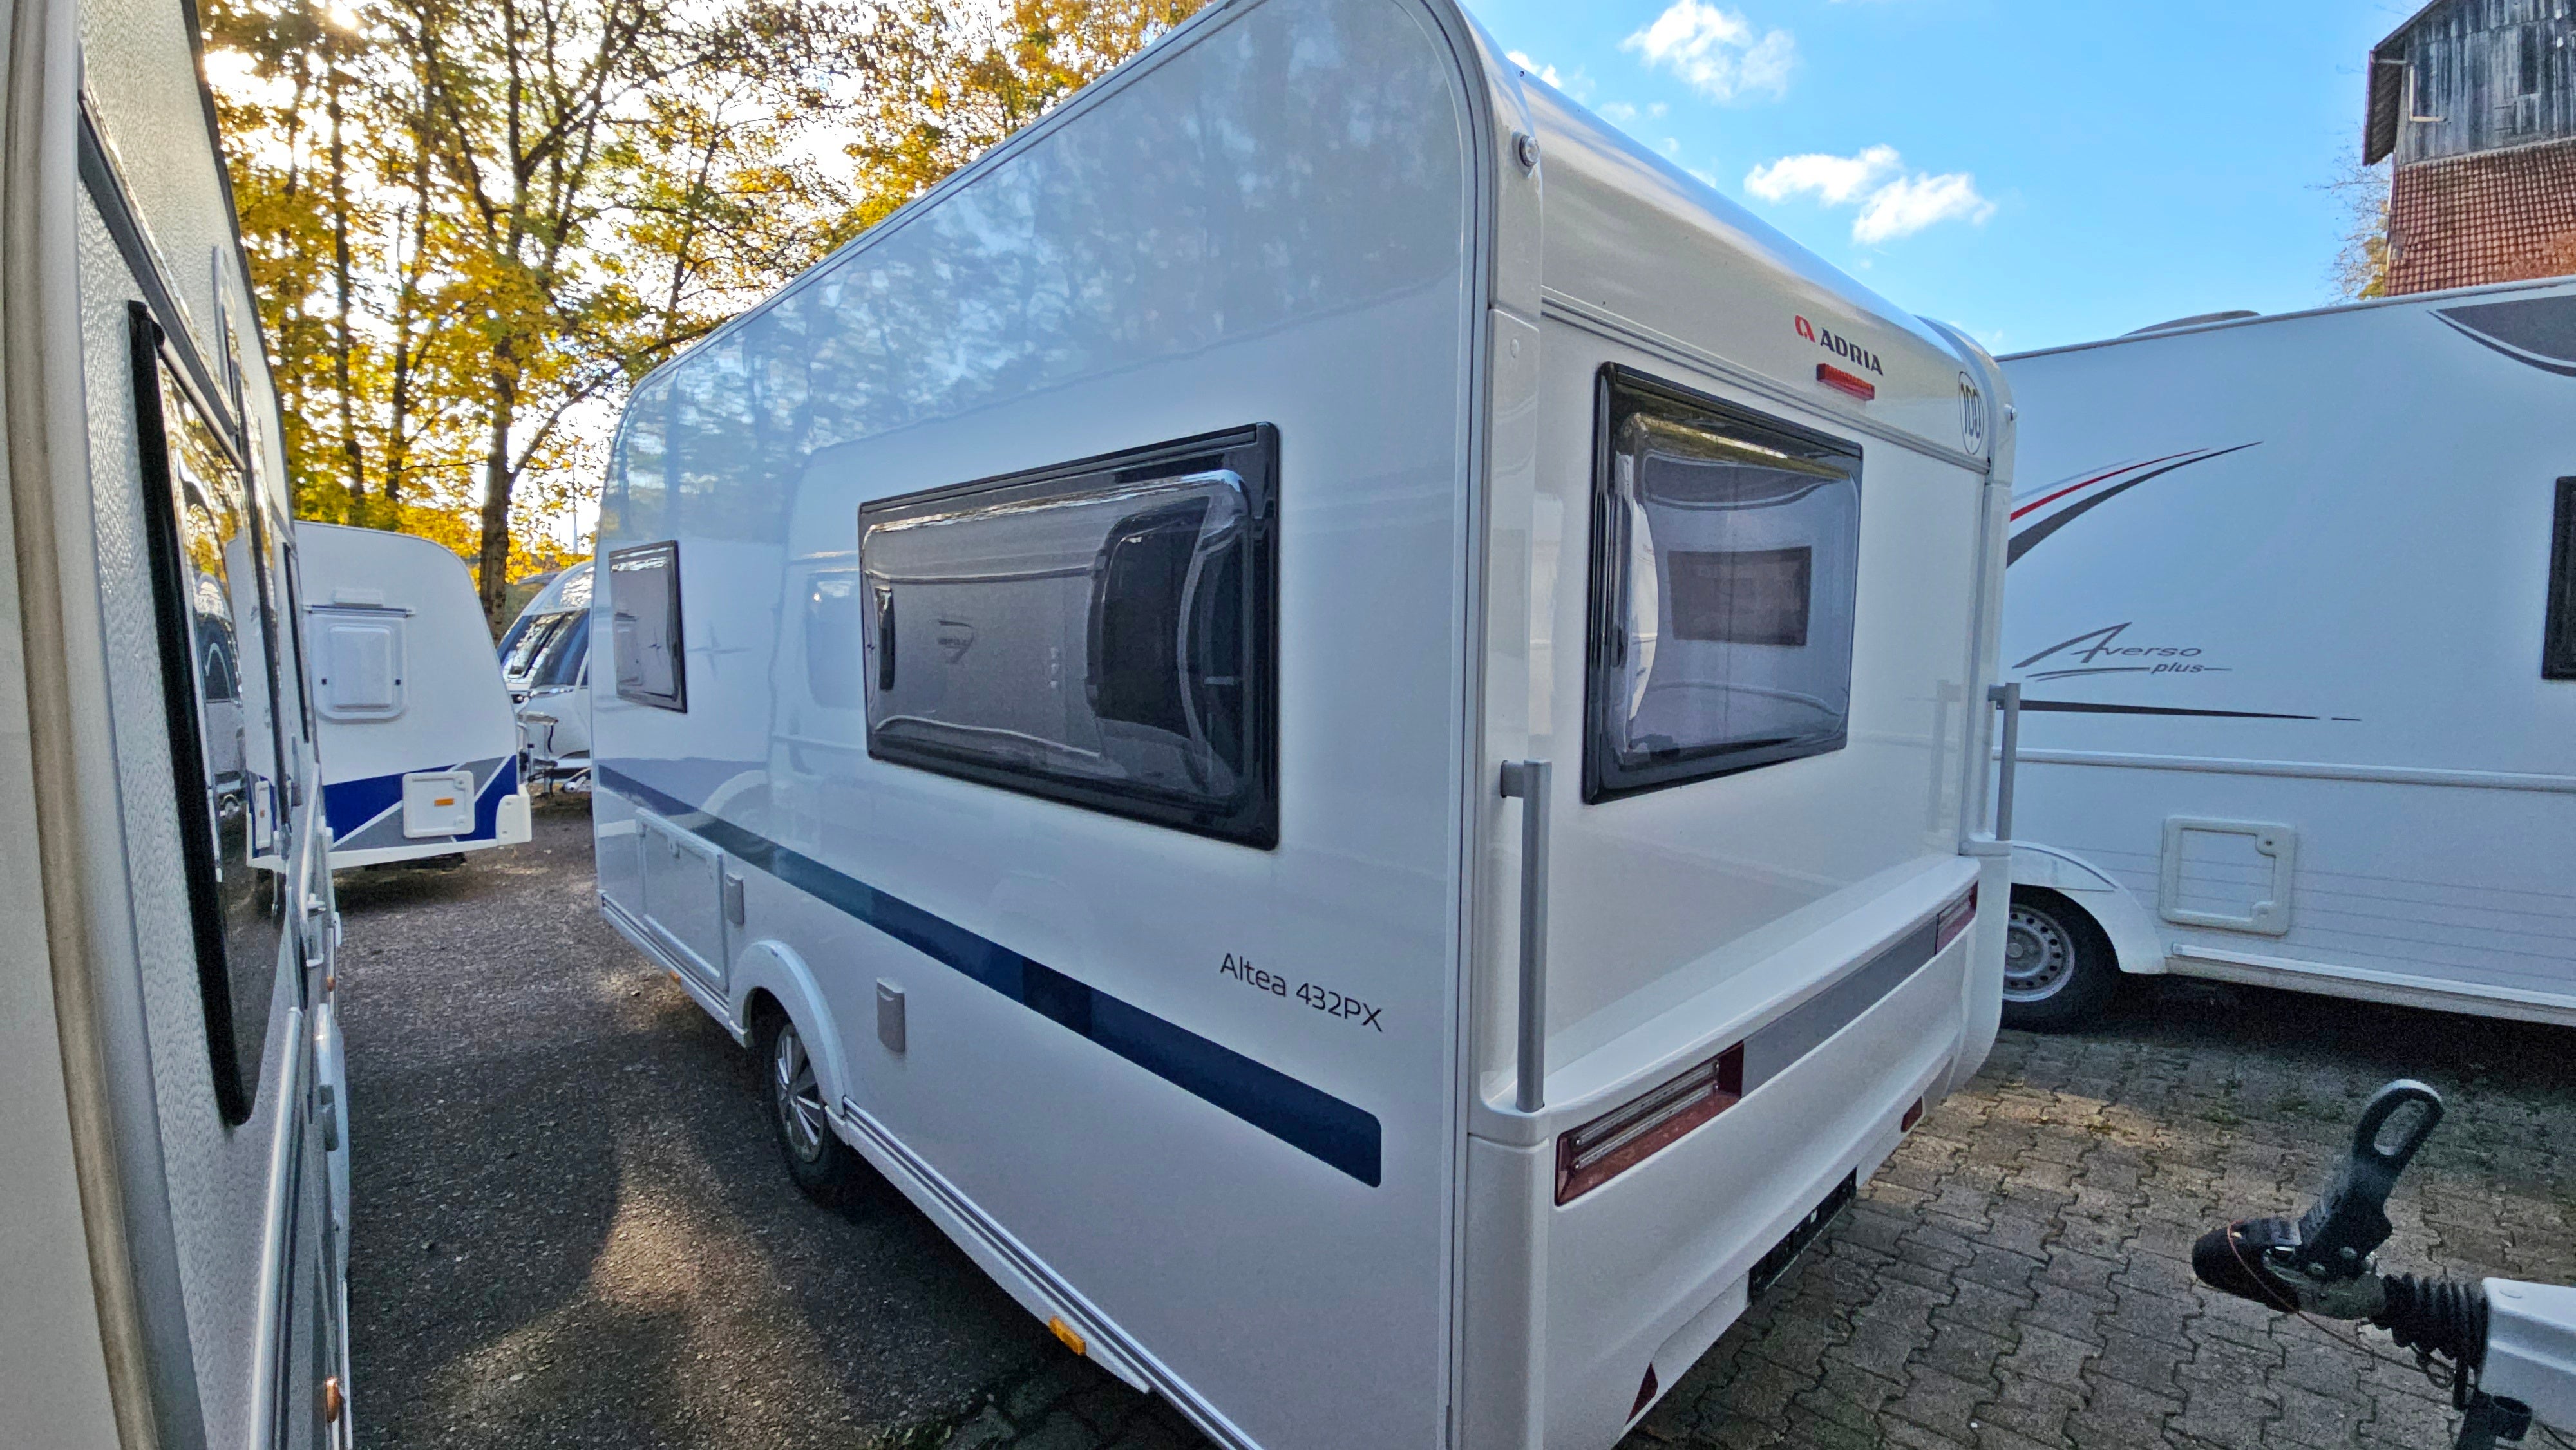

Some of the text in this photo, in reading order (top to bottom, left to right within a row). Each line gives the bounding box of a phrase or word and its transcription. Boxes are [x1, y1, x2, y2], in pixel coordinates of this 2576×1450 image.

[1820, 327, 1884, 377] ADRIA
[1959, 382, 1981, 440] 100
[2011, 621, 2204, 669] Averso
[2150, 661, 2205, 675] plus
[1220, 952, 1383, 1033] Altea 432PX
